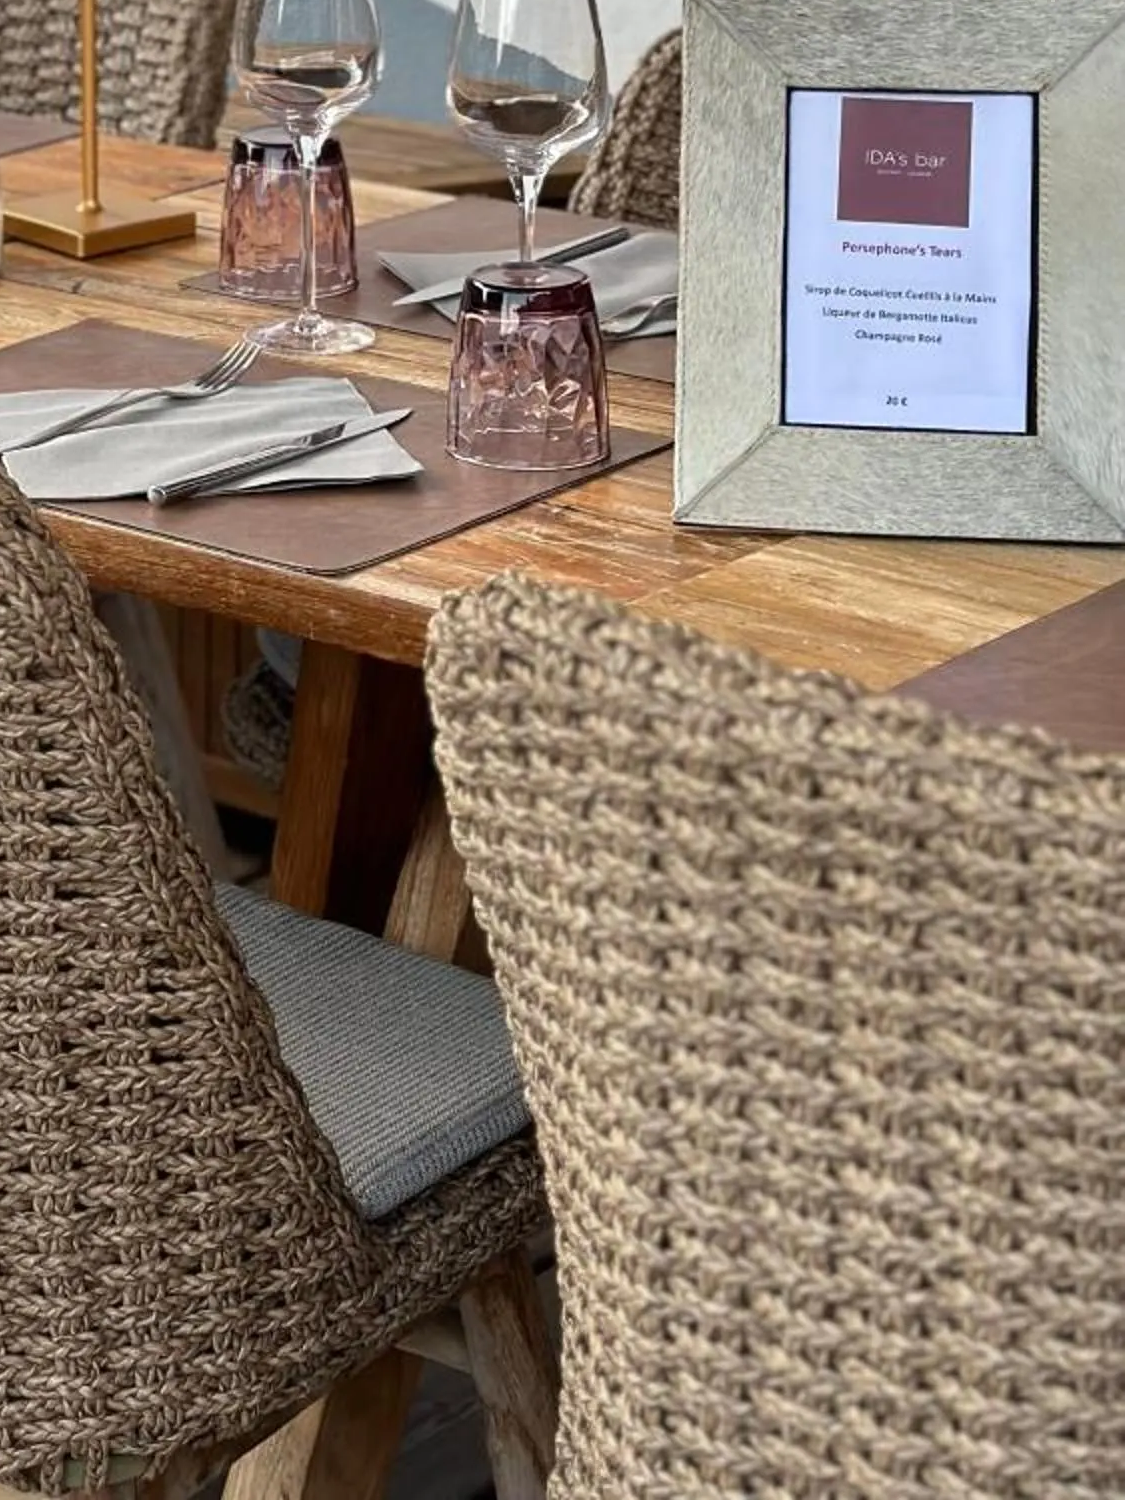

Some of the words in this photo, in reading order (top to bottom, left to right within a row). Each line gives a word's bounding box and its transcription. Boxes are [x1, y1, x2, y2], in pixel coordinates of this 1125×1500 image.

[865, 148, 908, 167] IDA's
[915, 151, 947, 169] bar
[842, 241, 926, 257] Persephone's
[929, 245, 962, 259] Tears
[833, 286, 847, 296] de
[863, 309, 876, 319] de
